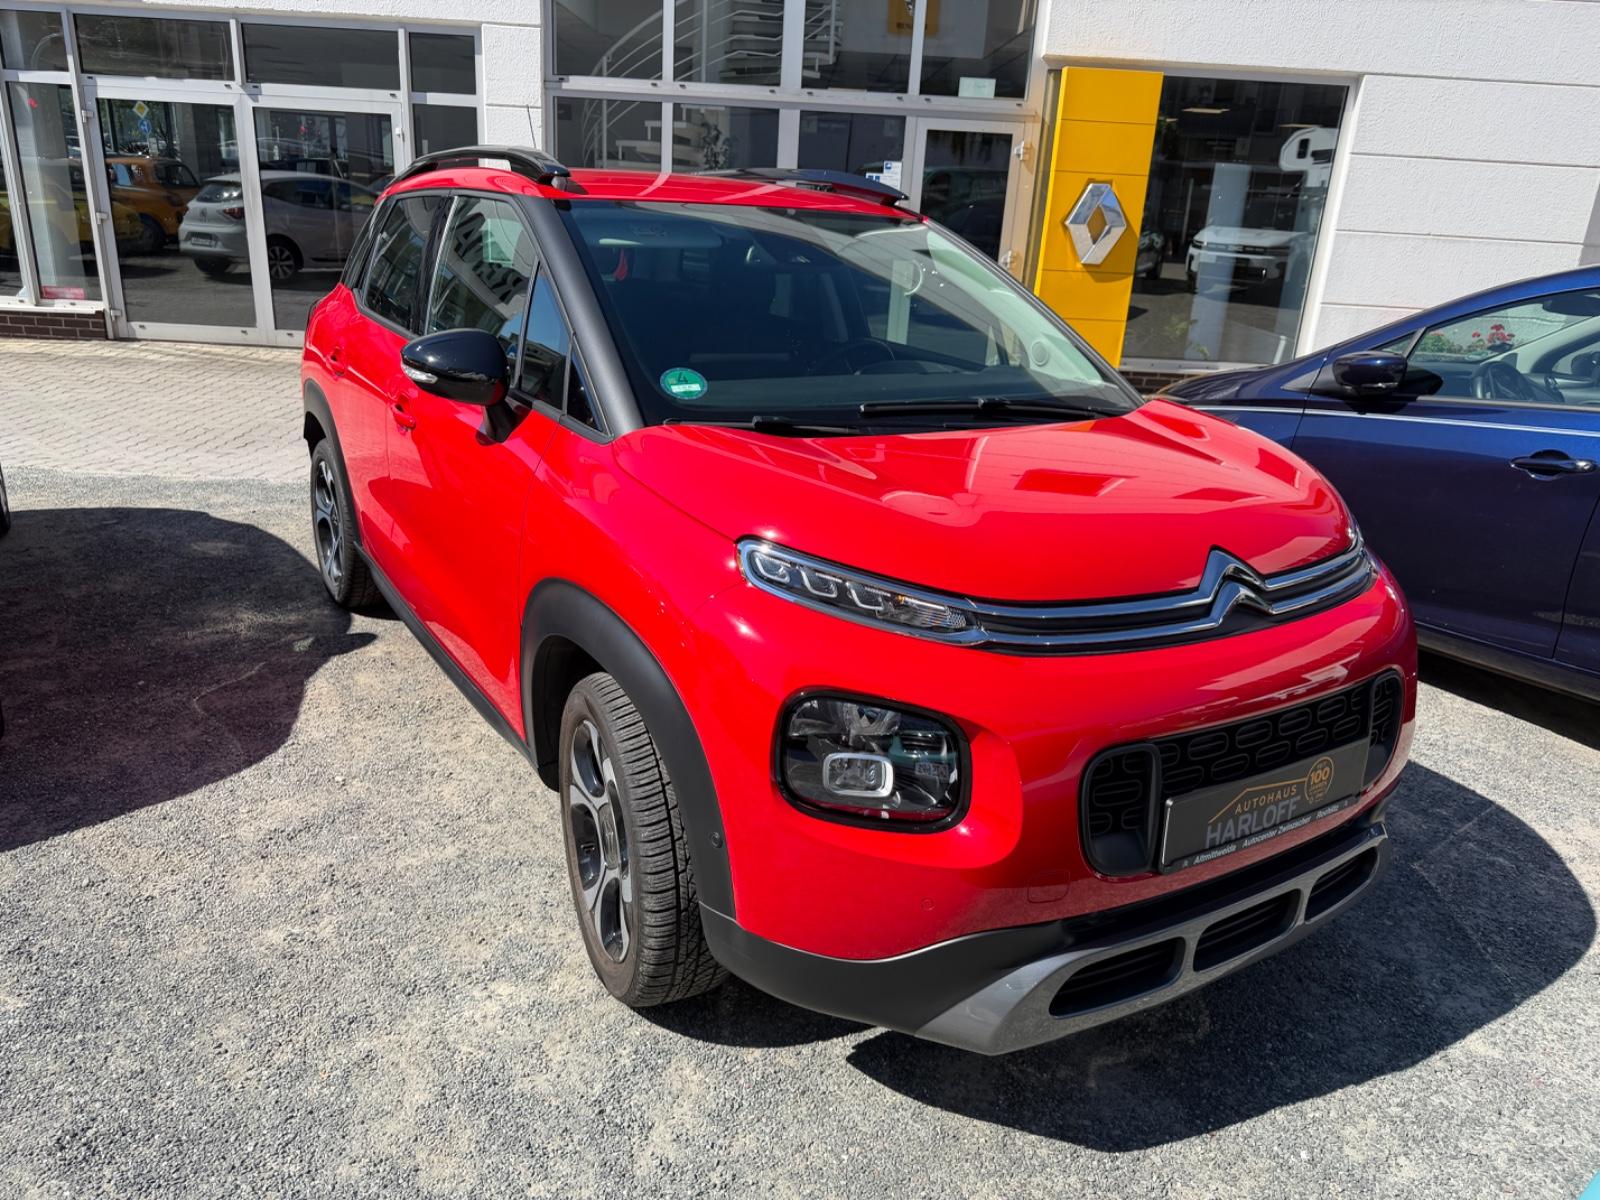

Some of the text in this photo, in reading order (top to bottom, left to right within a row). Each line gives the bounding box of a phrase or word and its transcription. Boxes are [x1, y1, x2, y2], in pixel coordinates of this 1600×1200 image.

[676, 371, 689, 384] 4
[1310, 767, 1330, 785] 100
[1234, 784, 1298, 815] AUTOHAUS
[1205, 794, 1301, 849] HARLOFF
